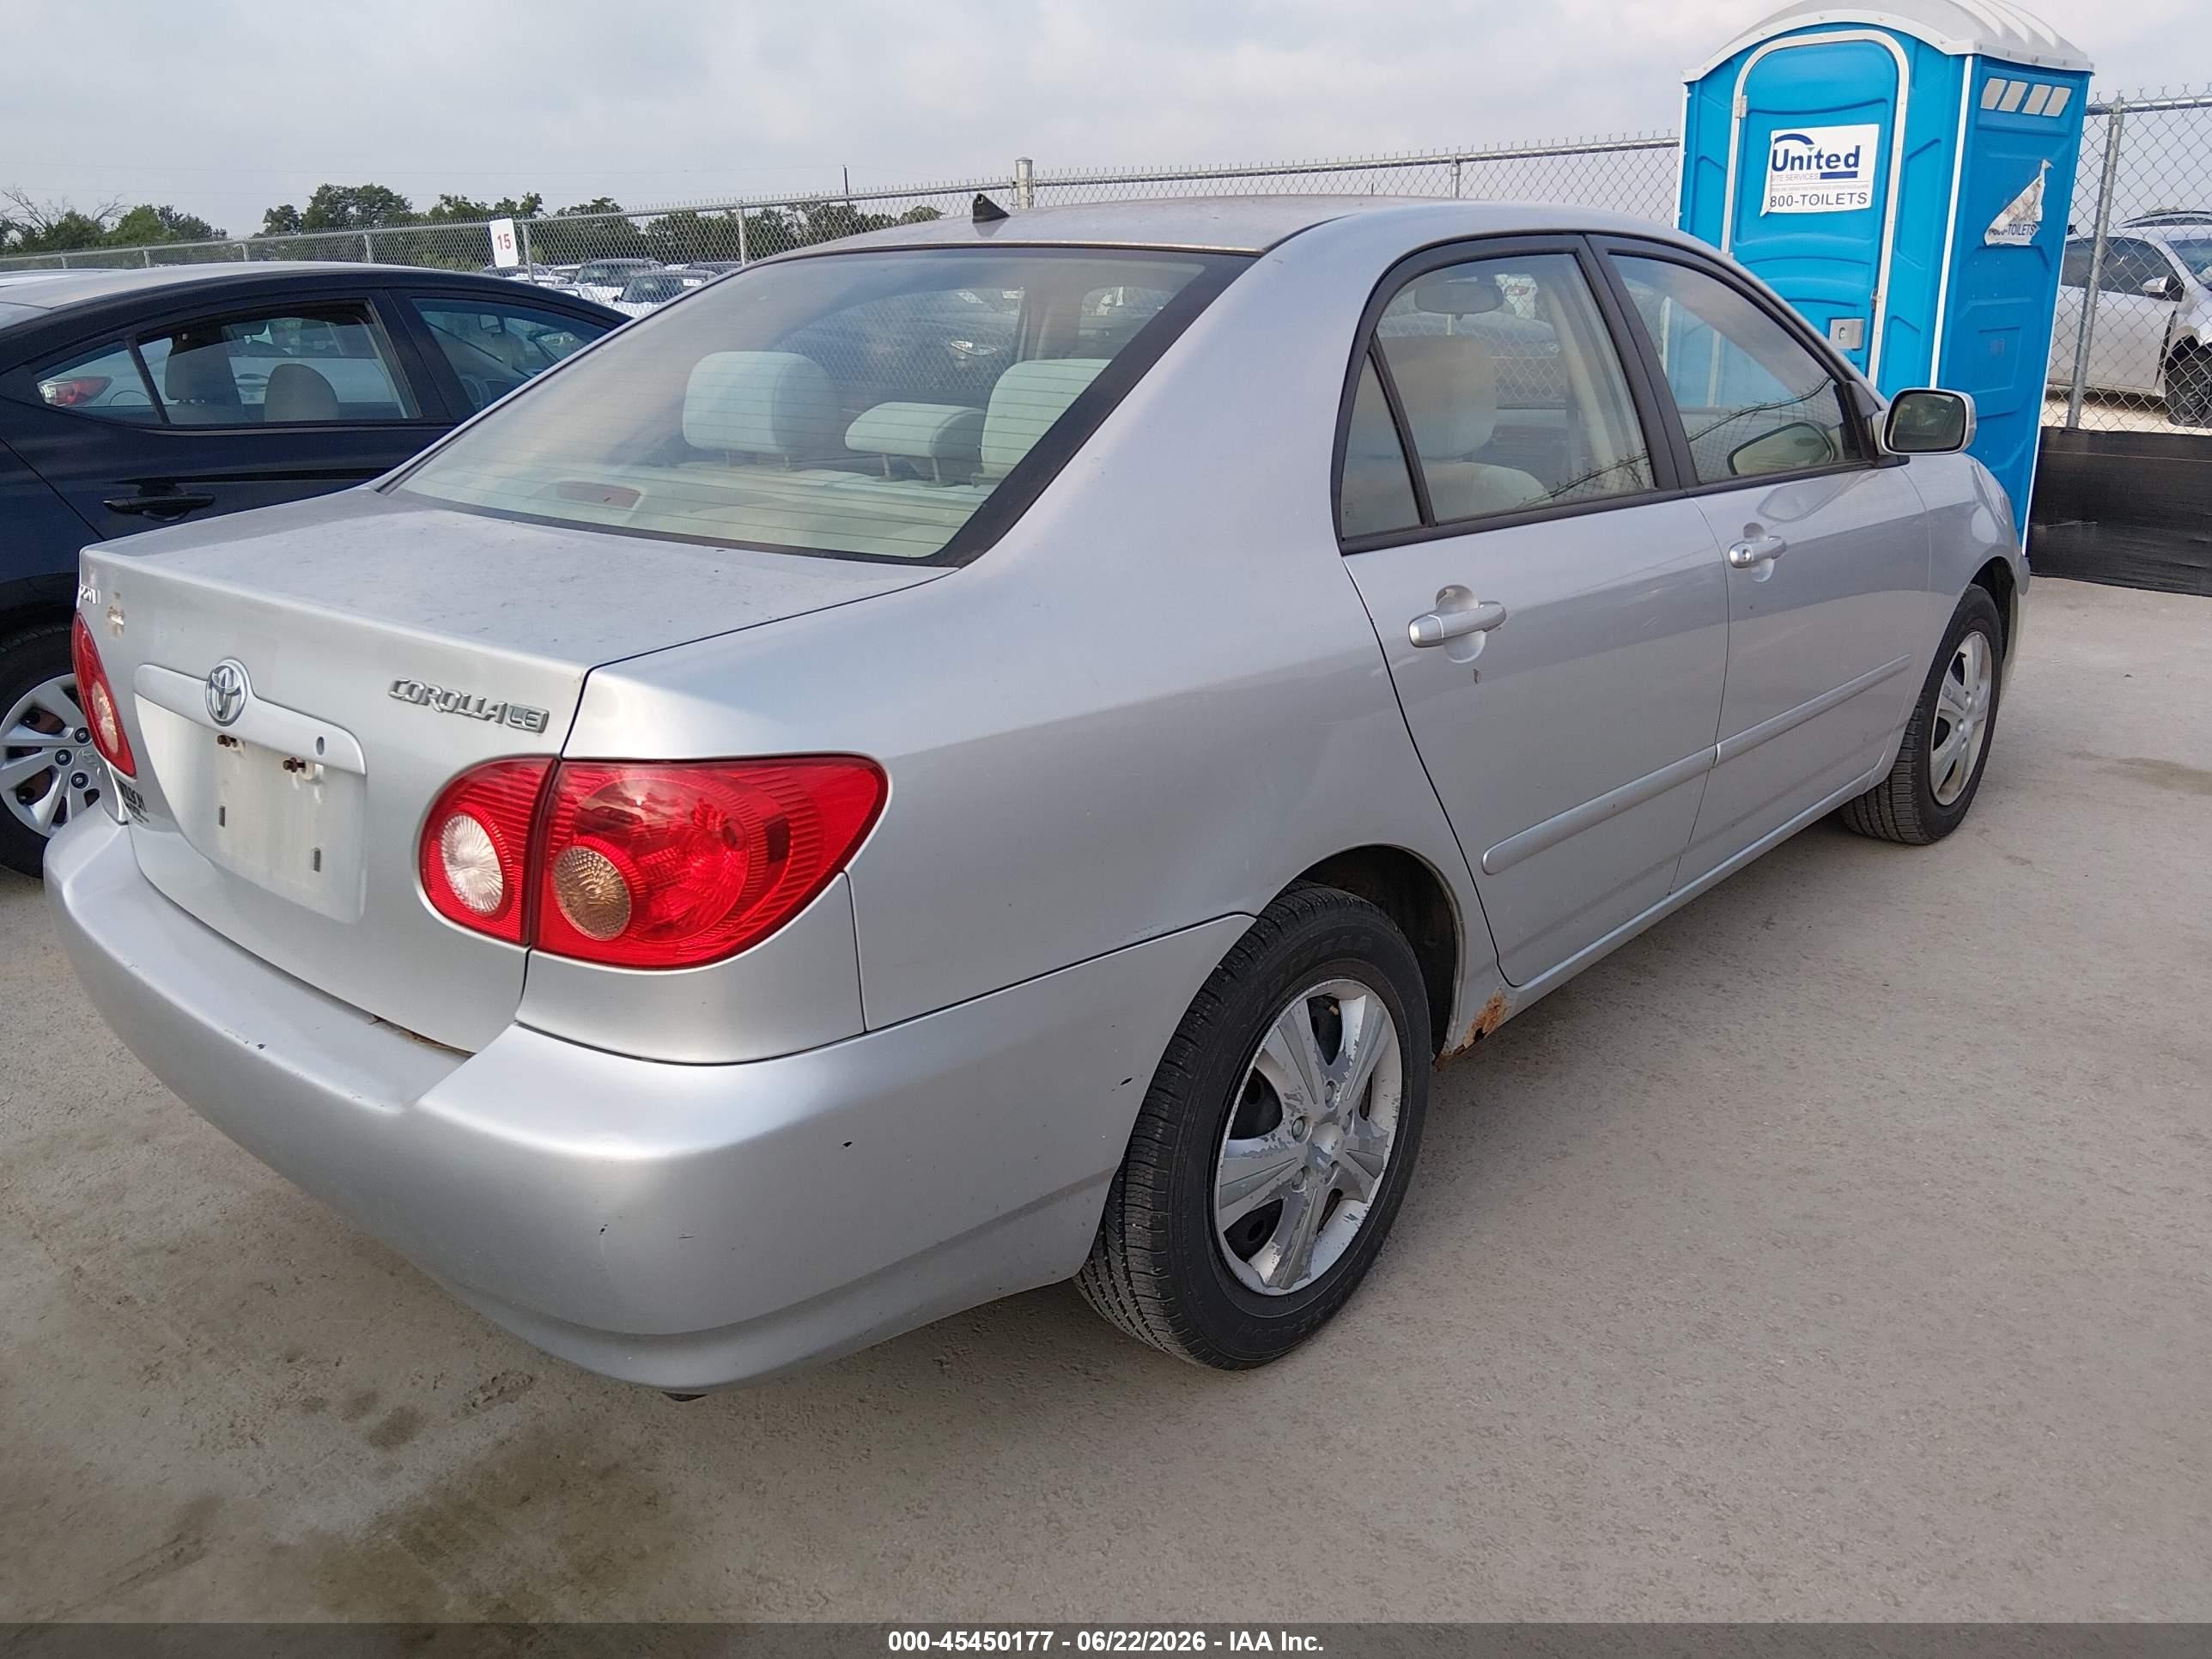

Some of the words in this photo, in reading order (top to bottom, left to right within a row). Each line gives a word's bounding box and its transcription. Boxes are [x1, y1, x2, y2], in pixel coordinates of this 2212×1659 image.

[1771, 144, 1861, 172] United
[1785, 173, 1820, 181] SERVICES
[1770, 192, 1869, 208] 800-TOILETS
[497, 233, 512, 251] 15
[388, 678, 508, 725] COROLLA
[507, 704, 548, 732] LE
